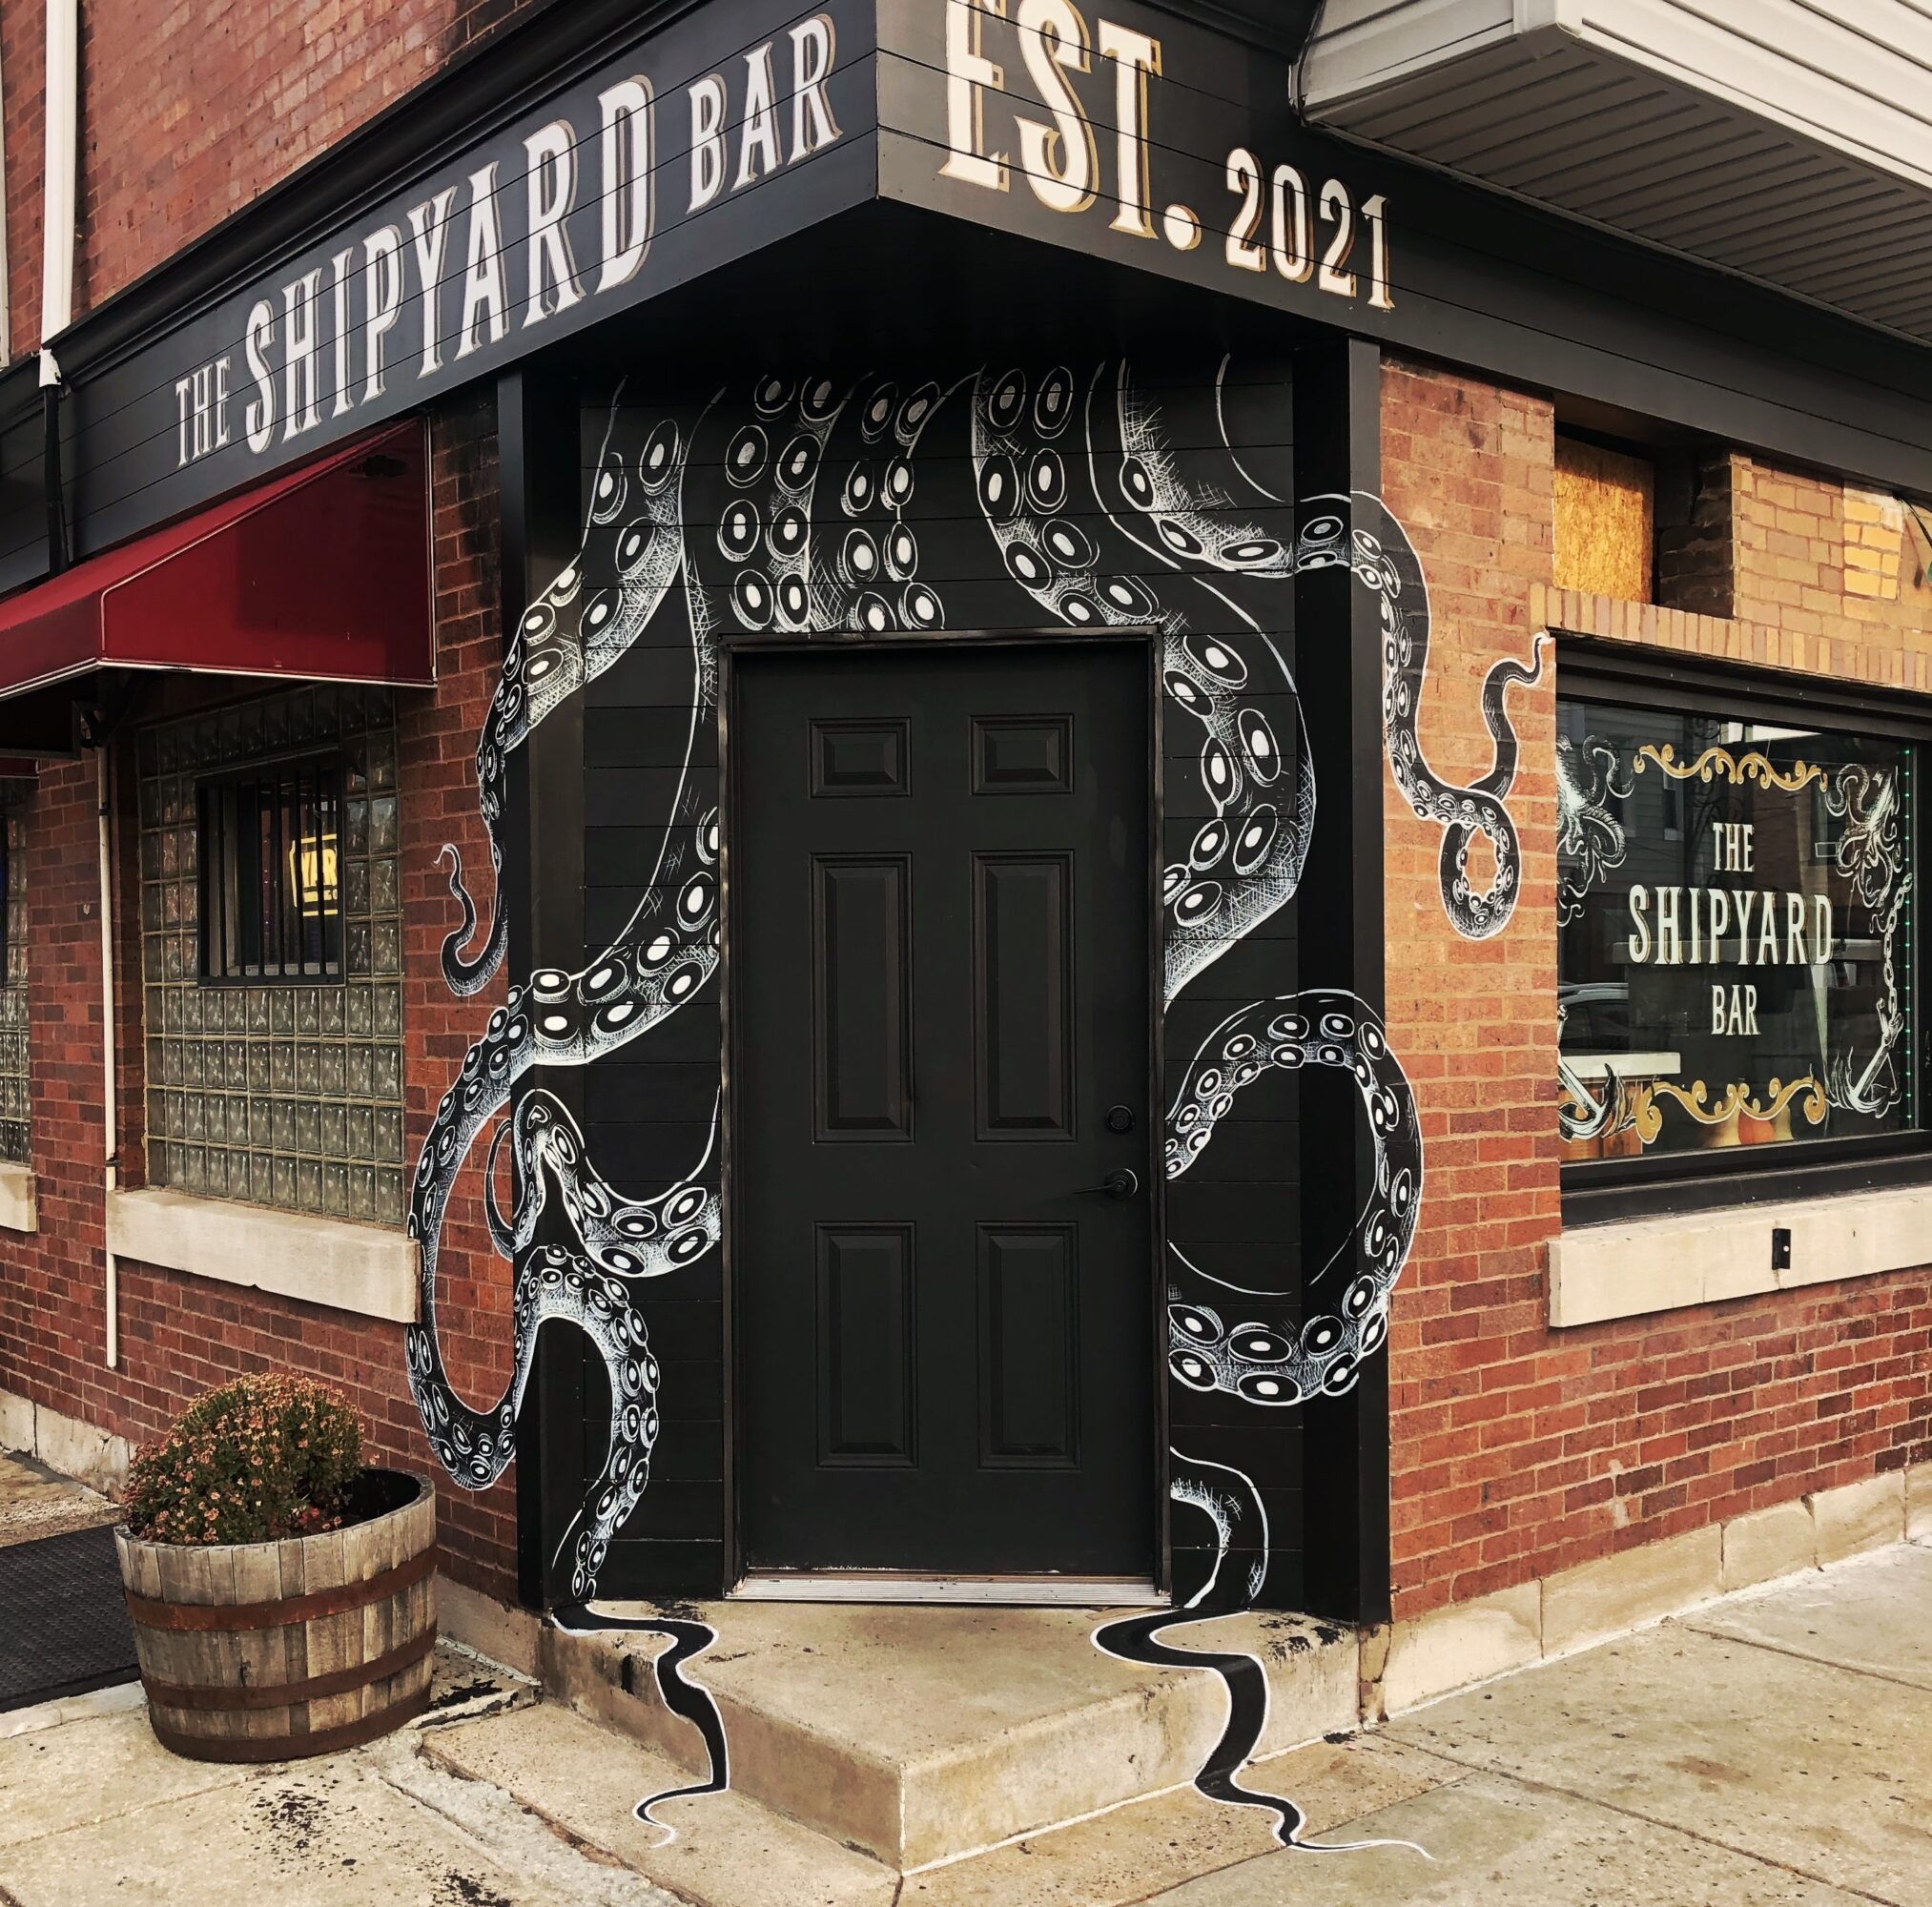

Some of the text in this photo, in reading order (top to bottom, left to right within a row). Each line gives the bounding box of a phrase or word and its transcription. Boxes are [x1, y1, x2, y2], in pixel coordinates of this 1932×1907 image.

[937, 0, 1396, 310] EST. 2021
[175, 12, 844, 468] THE SHIPYARD BAR
[1713, 822, 1756, 872] THE
[1628, 883, 1834, 966] SHIPYARD
[1711, 984, 1762, 1036] BAR
